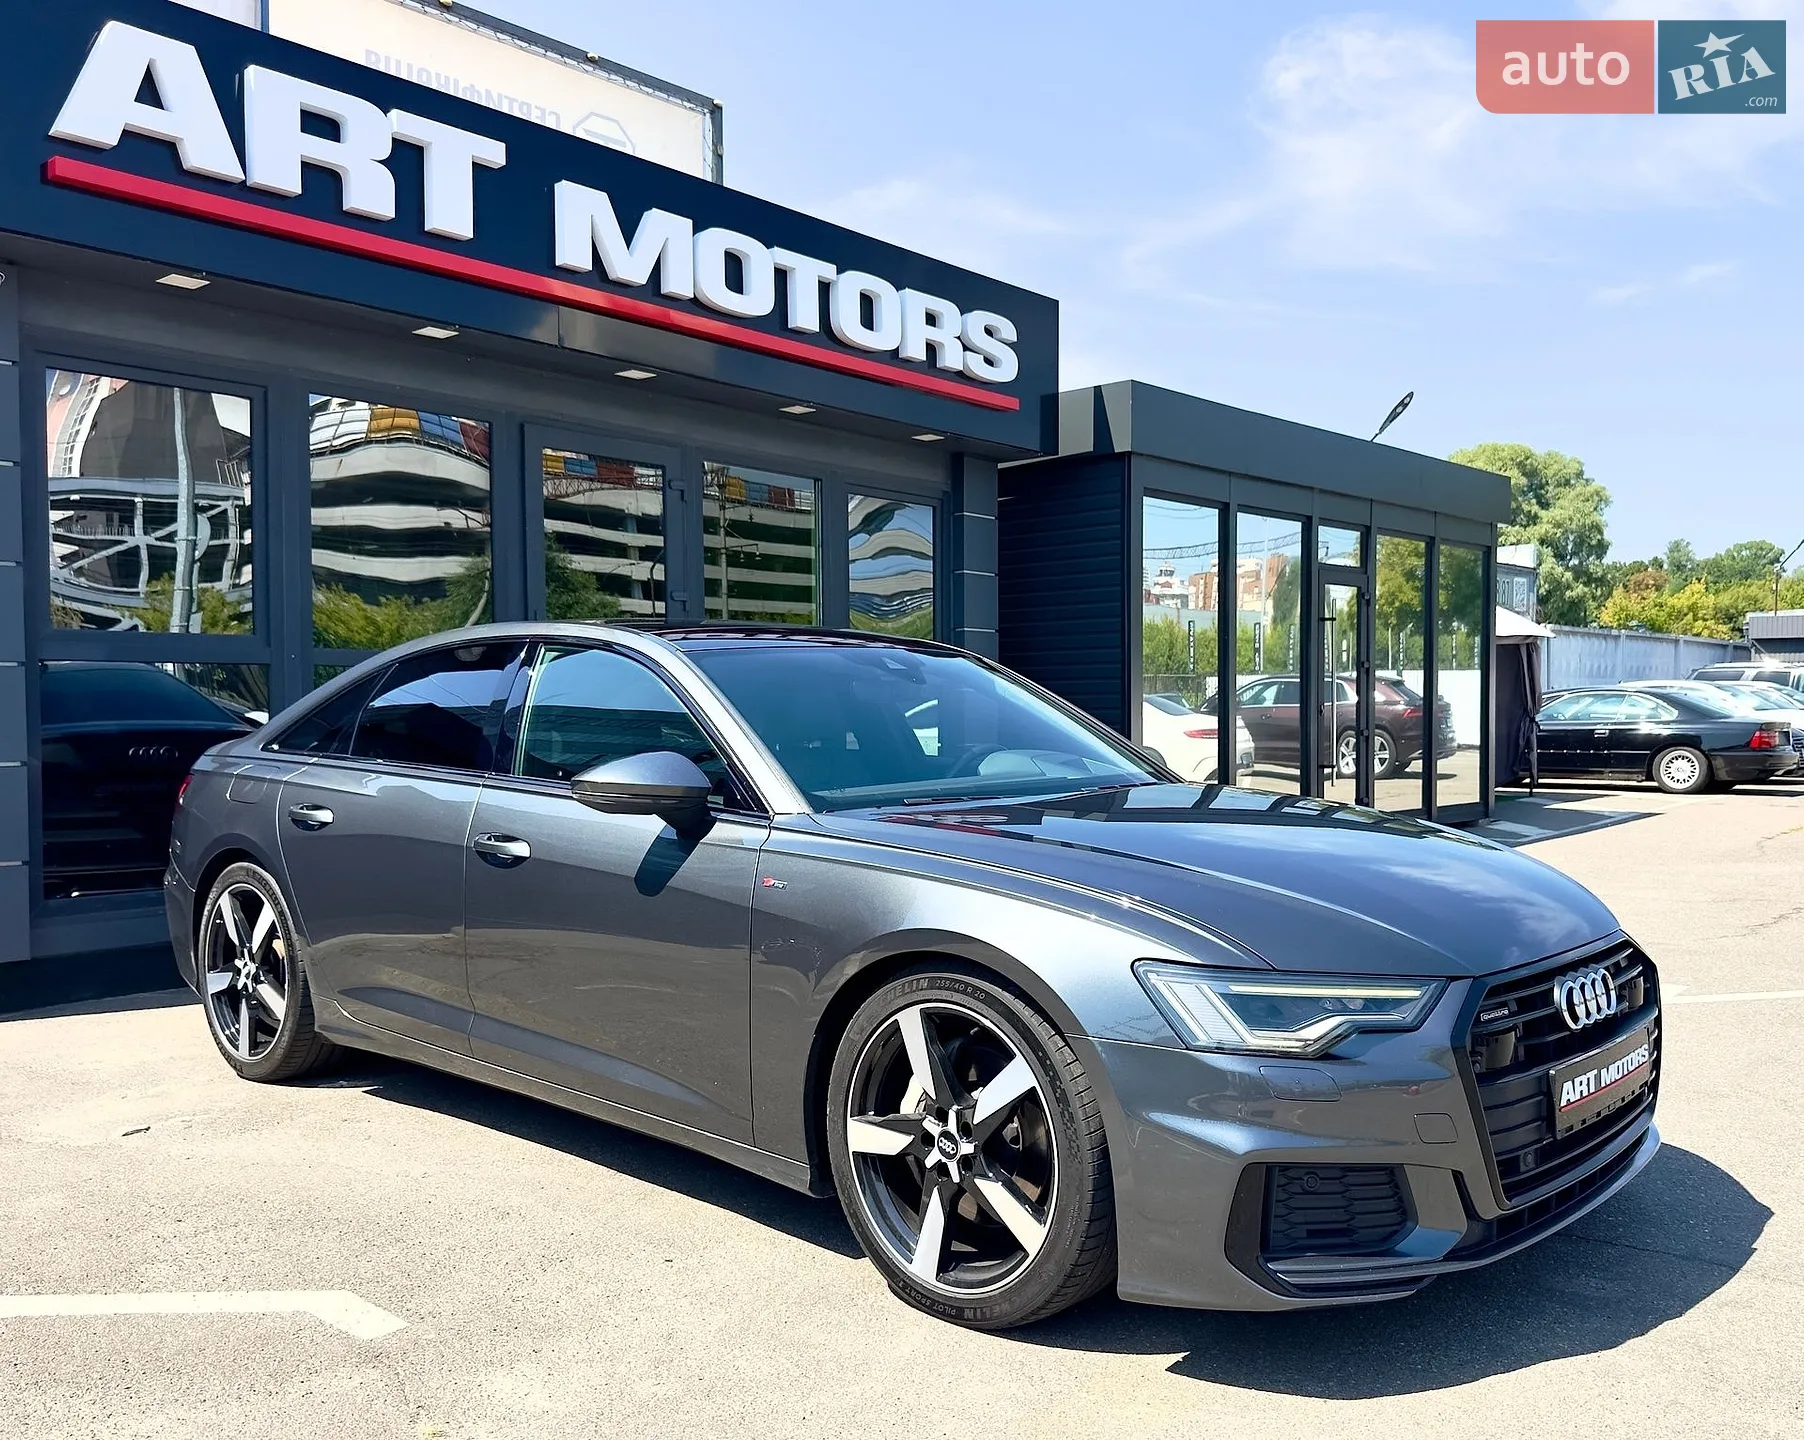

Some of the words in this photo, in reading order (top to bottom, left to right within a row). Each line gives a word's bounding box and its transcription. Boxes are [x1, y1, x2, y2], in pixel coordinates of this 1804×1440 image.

[48, 20, 506, 240] ART
[554, 180, 1019, 384] MOTORS
[935, 980, 965, 991] 255/40
[966, 985, 973, 994] R
[974, 990, 986, 1000] 20
[1560, 1069, 1598, 1107] ART
[1600, 1044, 1649, 1088] MOTORS
[905, 1286, 932, 1306] SPORT
[933, 1303, 957, 1316] PILOT
